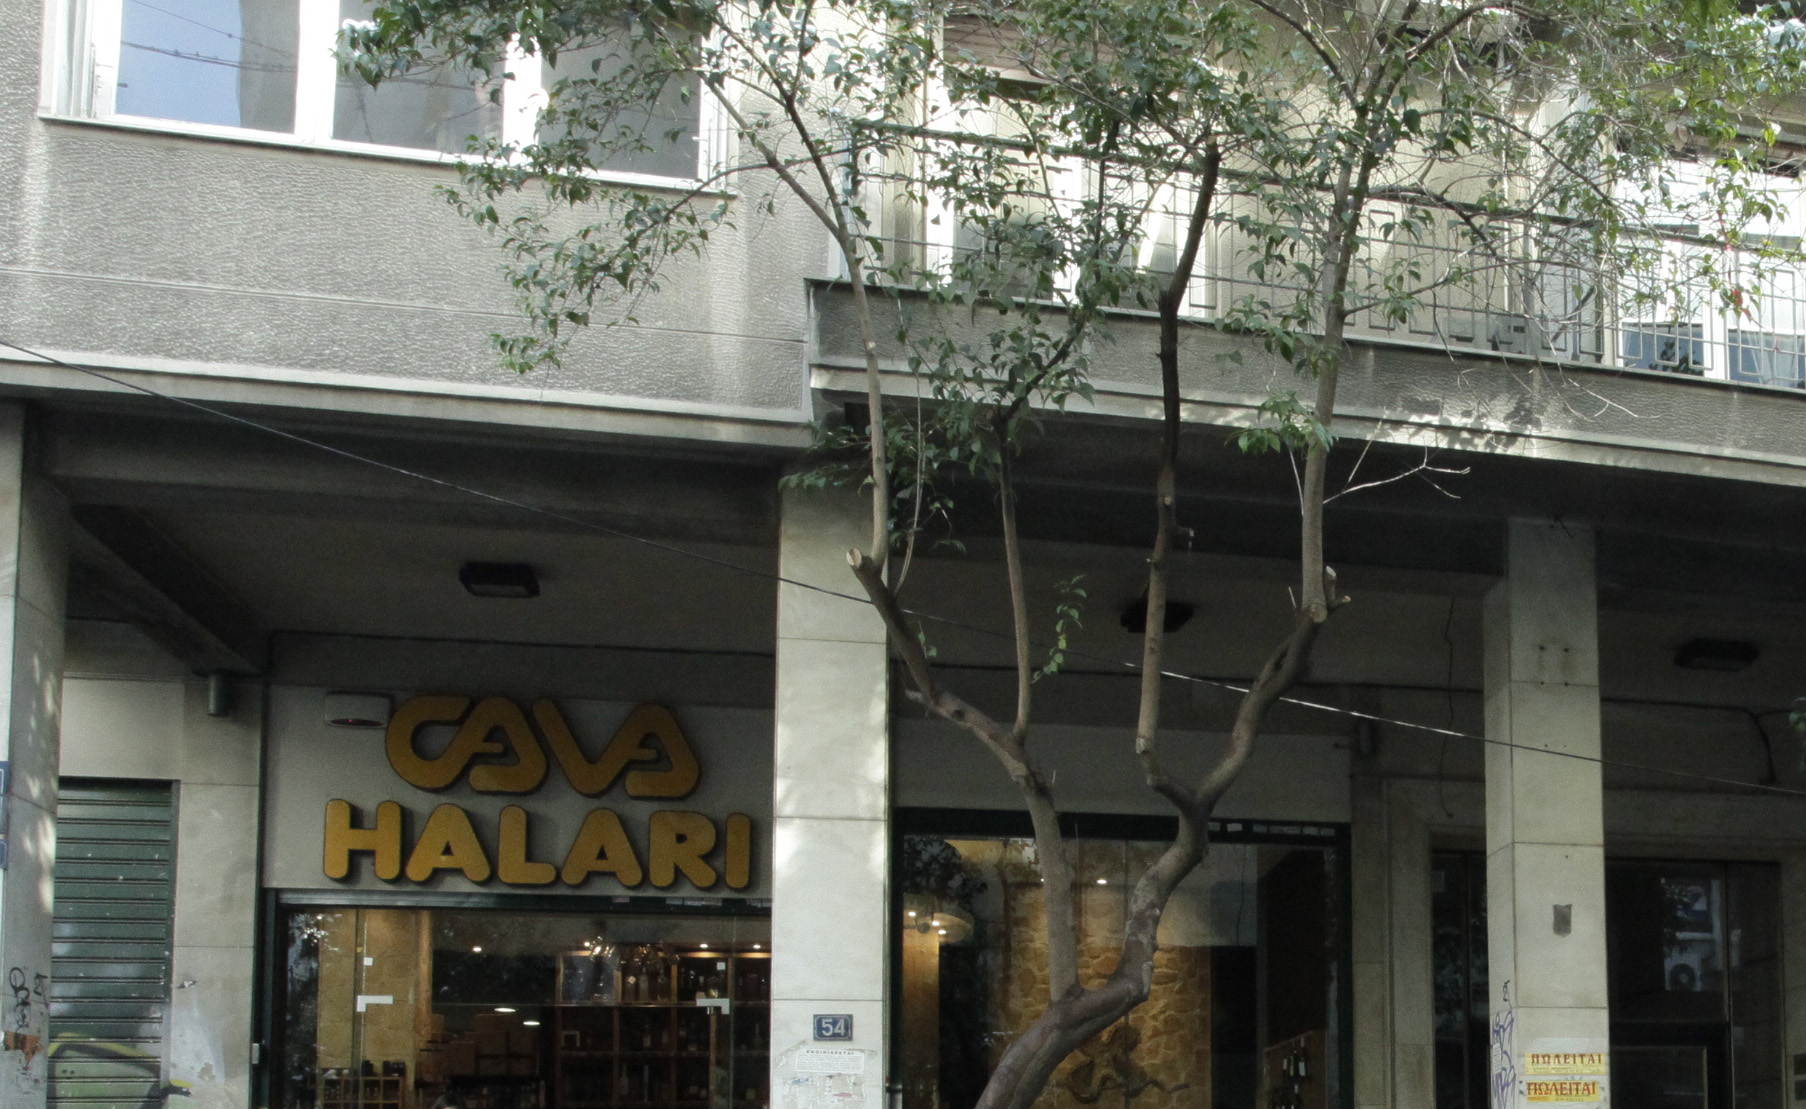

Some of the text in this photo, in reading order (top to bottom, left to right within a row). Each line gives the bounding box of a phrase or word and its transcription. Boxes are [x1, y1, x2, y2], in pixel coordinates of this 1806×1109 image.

[385, 694, 700, 799] CAVA
[323, 798, 752, 890] HALARI
[821, 1018, 846, 1037] 54
[1531, 1053, 1602, 1065] ΠΩΛΕΙΤΑΙ
[1527, 1081, 1596, 1096] ΠΩΛΕΙΤΑΙ
